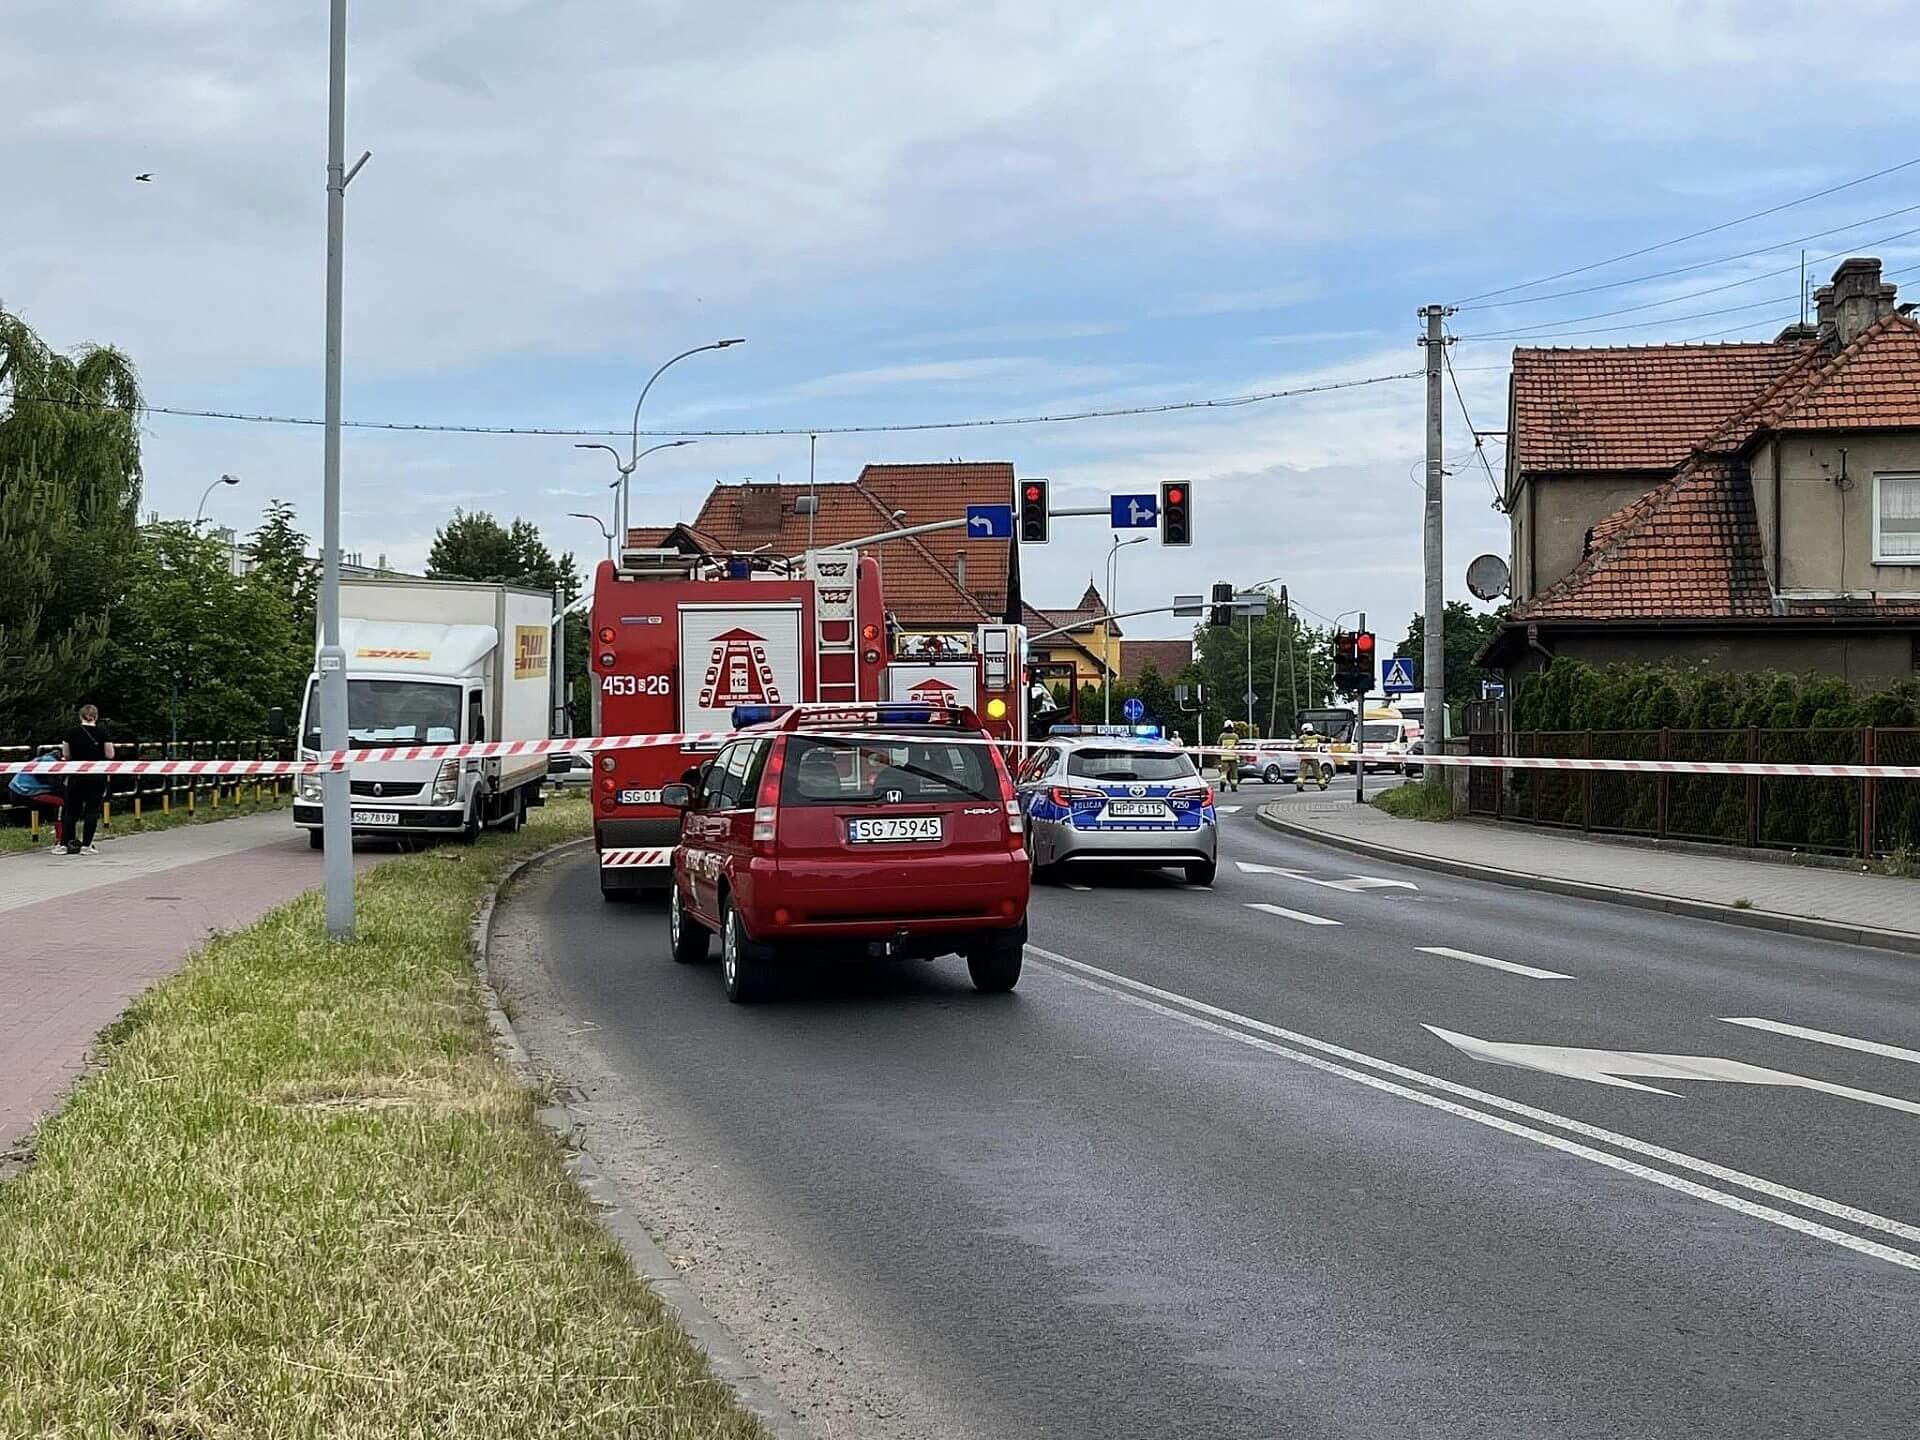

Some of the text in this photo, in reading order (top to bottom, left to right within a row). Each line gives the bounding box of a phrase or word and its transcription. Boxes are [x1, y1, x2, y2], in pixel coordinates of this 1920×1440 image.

[367, 650, 418, 659] DHL
[602, 675, 636, 696] 453
[647, 675, 670, 695] 26
[731, 678, 747, 687] 112
[624, 791, 641, 802] SG
[1073, 801, 1103, 809] POLICJA
[1138, 803, 1164, 814] G115
[1172, 800, 1190, 809] P250
[355, 813, 369, 822] SG
[859, 819, 939, 837] SG 75945
